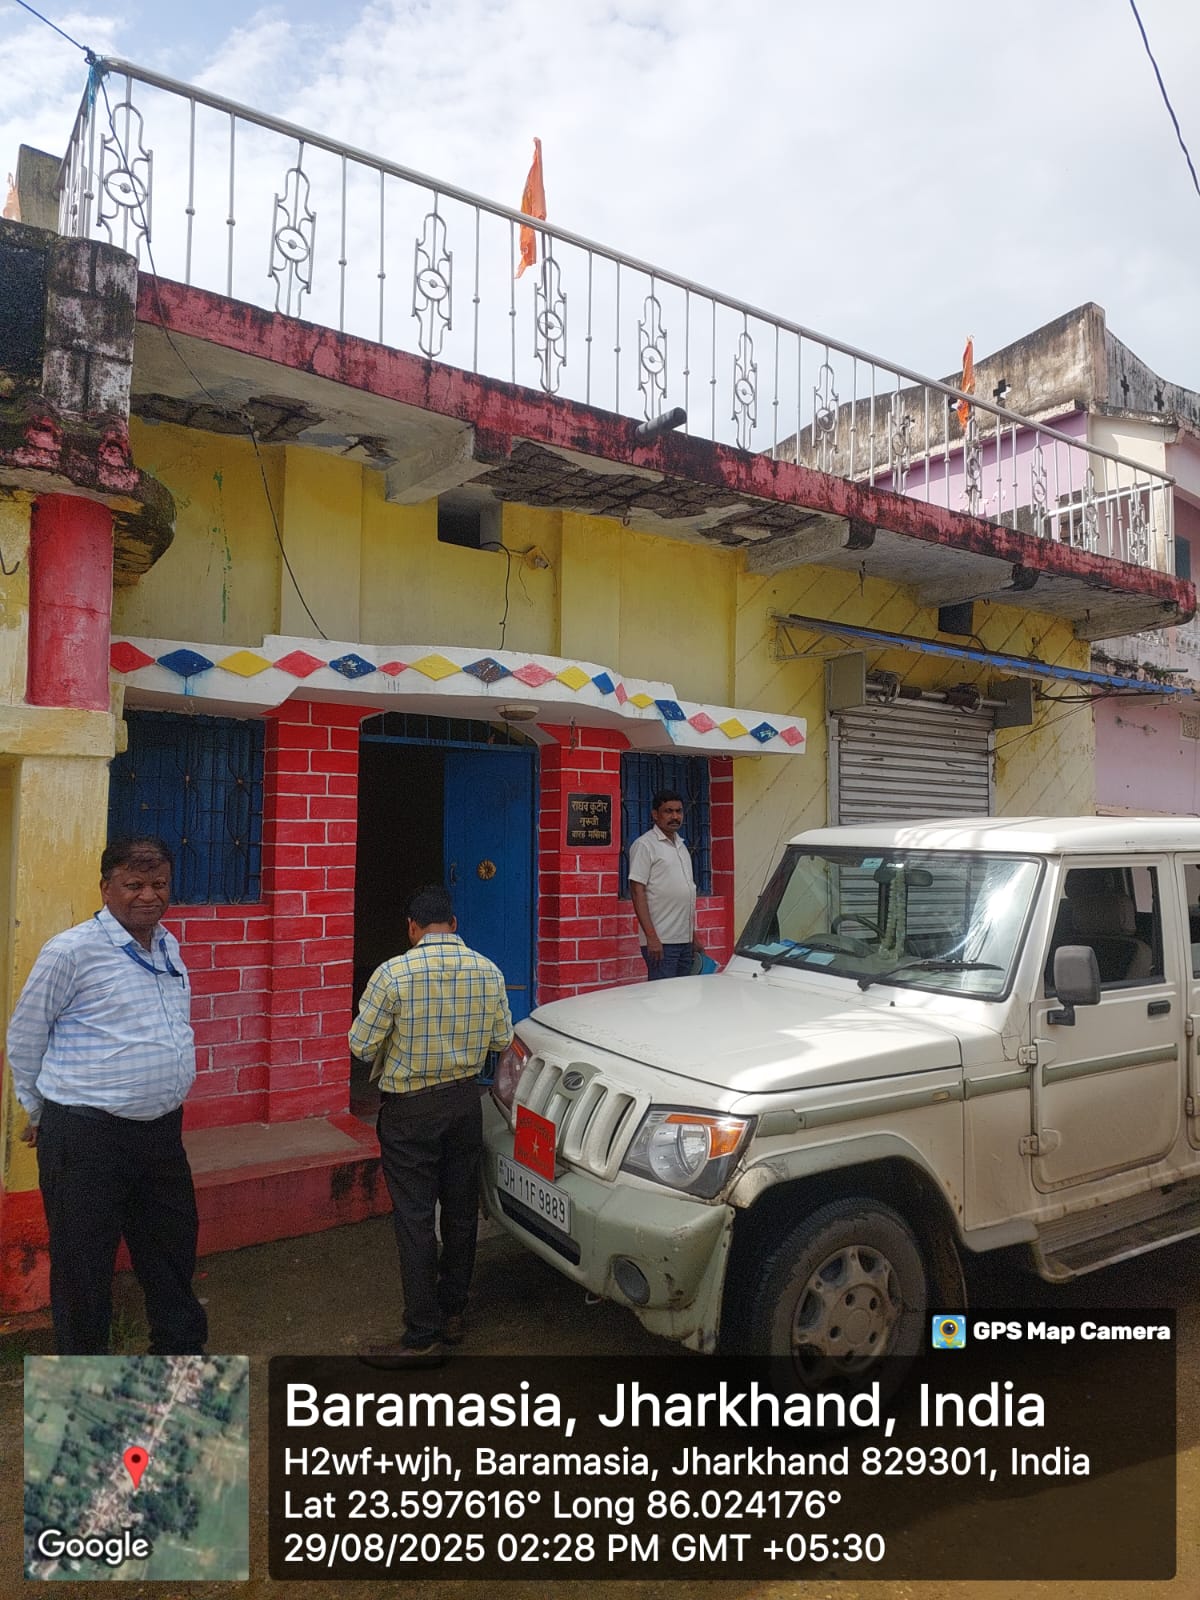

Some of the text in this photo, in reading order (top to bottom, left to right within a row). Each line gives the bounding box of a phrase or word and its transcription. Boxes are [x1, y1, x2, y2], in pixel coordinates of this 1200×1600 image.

[590, 800, 608, 814] कुटीर
[504, 1166, 516, 1192] JH
[519, 1176, 536, 1203] 11F
